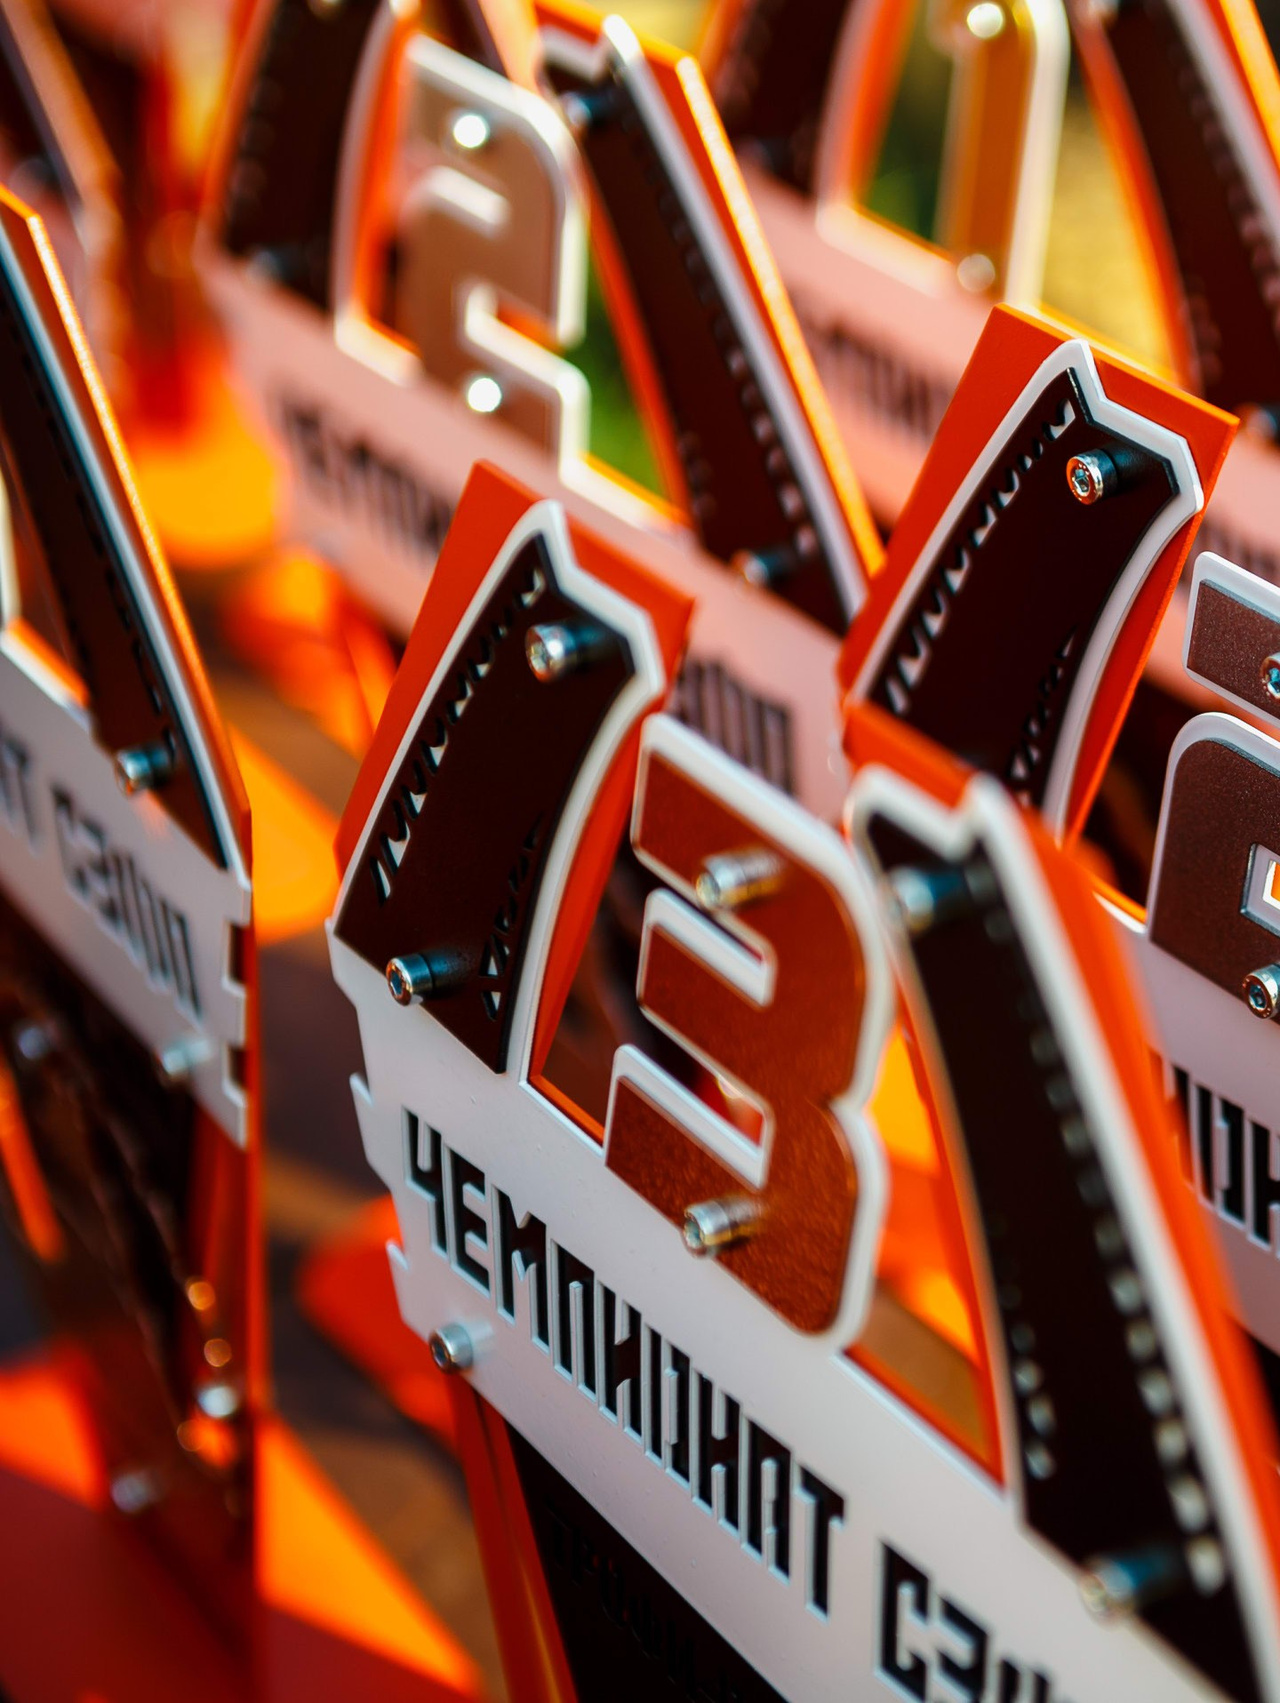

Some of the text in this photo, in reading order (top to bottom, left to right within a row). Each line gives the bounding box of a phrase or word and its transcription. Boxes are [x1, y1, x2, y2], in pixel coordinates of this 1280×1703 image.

[396, 30, 594, 486] 2
[603, 711, 895, 1338] 3
[402, 1106, 846, 1622] ЧЕМПИОНАТ
